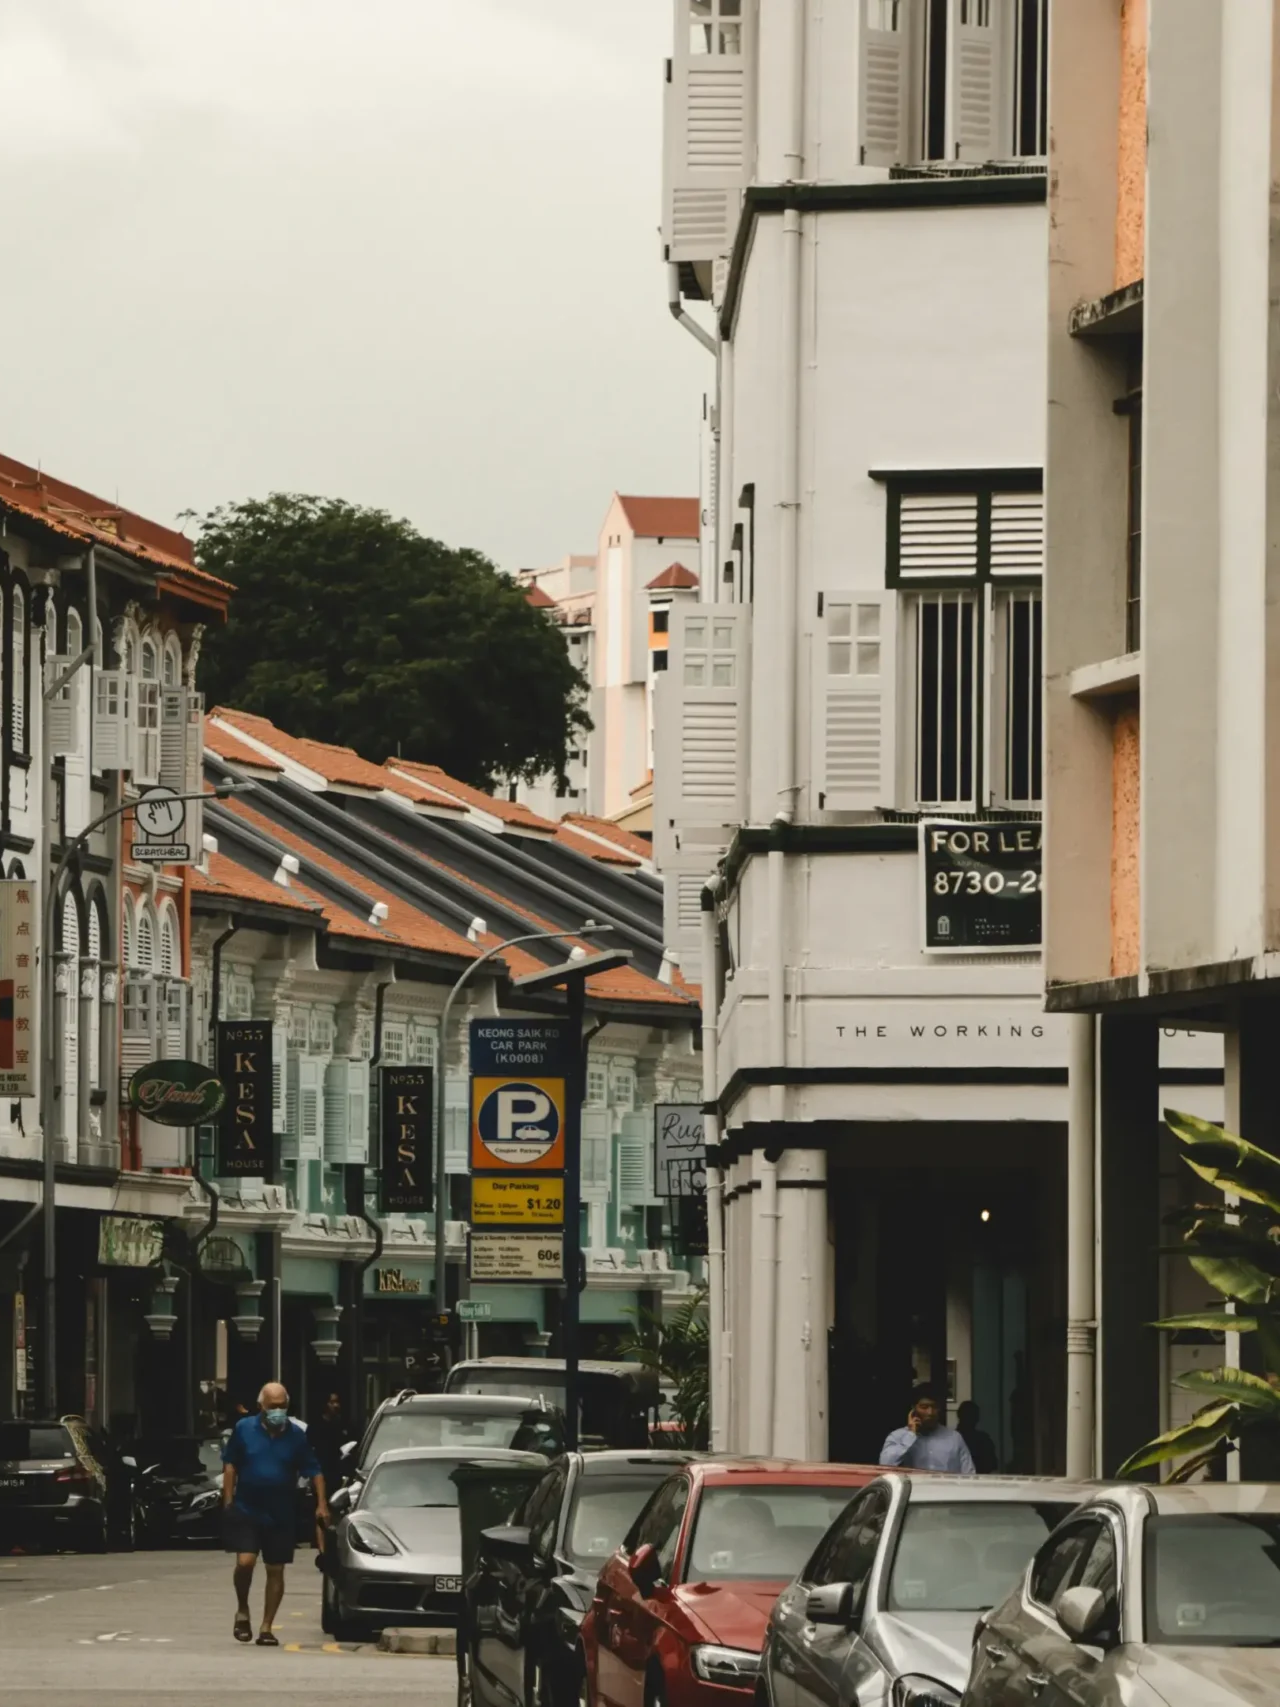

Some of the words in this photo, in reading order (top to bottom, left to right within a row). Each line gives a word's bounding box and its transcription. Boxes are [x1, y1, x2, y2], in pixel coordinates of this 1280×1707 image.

[931, 831, 990, 854] FOR
[16, 888, 30, 1065] 焦点音乐教室
[478, 1029, 514, 1038] KEONG
[517, 1029, 541, 1038] SAIK
[836, 1025, 888, 1038] THE
[910, 1025, 1045, 1038] WORKING
[490, 1041, 513, 1051] CAR
[518, 1041, 547, 1051] PARK
[234, 1052, 258, 1150] KESA
[497, 1091, 551, 1139] P
[662, 1112, 705, 1152] Rug
[396, 1095, 419, 1187] KESA
[226, 1159, 265, 1169] HOUSE
[492, 1182, 507, 1192] Day
[509, 1182, 539, 1192] Parking
[527, 1198, 561, 1211] $1.20
[537, 1250, 561, 1263] 60¢
